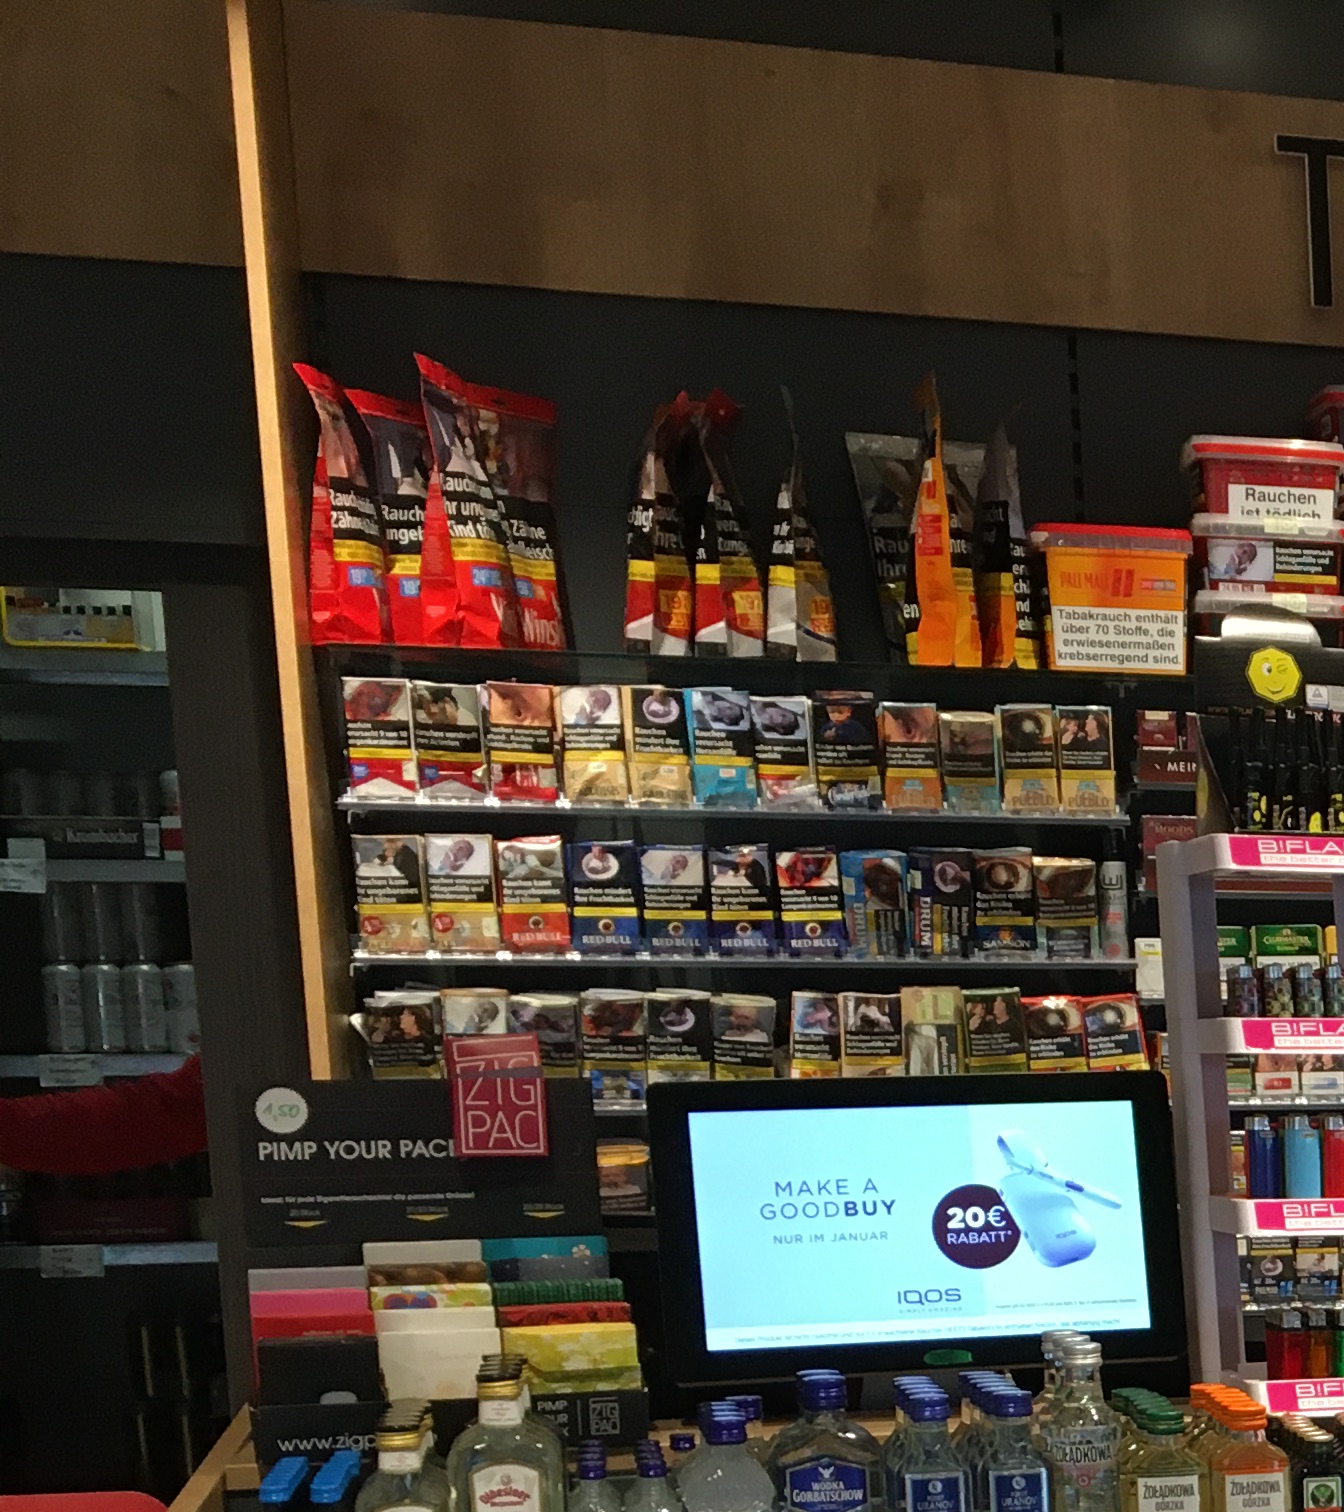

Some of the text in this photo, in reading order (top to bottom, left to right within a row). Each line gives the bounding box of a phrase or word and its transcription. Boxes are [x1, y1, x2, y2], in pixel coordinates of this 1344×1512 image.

[1245, 487, 1317, 505] Rauchen
[1057, 609, 1178, 624] Tabakrauch enthält
[1062, 624, 1175, 638] über 70 Stoffe, die
[1062, 637, 1175, 651] erwiesenermaßen
[1058, 650, 1181, 665] krebserregend sind.
[1263, 855, 1287, 863] the
[1290, 856, 1335, 864] better
[465, 1058, 535, 1105] ZIG
[467, 1111, 538, 1148] PAC
[258, 1140, 318, 1161] PIMP
[323, 1139, 392, 1159] YOUR
[774, 1177, 879, 1198] MAKE A
[760, 1199, 896, 1221] GOODBUY
[946, 1205, 1007, 1229] 20€
[773, 1230, 889, 1245] NUR IM JANUAR
[897, 1288, 962, 1306] IQOS
[811, 1480, 846, 1492] WODKA
